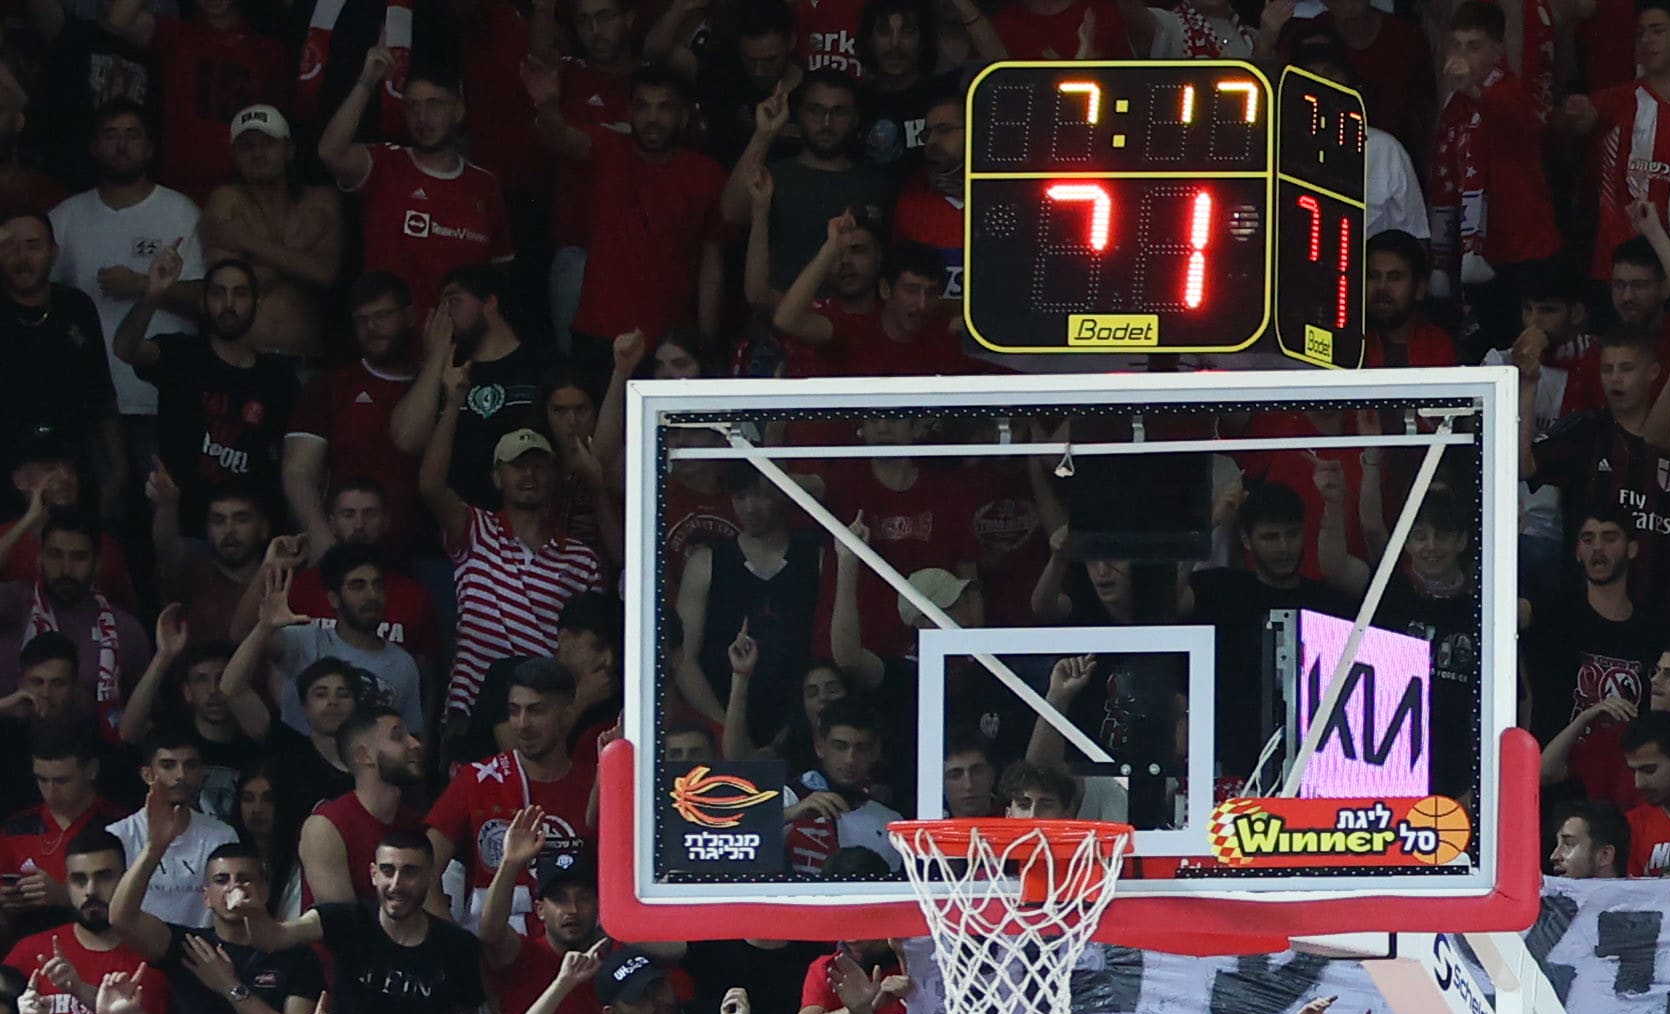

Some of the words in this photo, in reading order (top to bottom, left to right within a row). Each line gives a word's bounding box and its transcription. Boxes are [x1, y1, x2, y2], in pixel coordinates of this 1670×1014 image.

[1057, 82, 1258, 148] 7:17
[1045, 184, 1213, 311] 71
[1298, 195, 1352, 331] 71
[1073, 319, 1158, 344] Bodet
[1305, 330, 1332, 360] Bodet
[1619, 488, 1647, 509] Fly
[1335, 802, 1393, 831] ליגת
[683, 831, 761, 848] מנהלת
[1233, 813, 1396, 857] Winner
[1399, 820, 1438, 853] סל
[687, 846, 756, 862] הליגה
